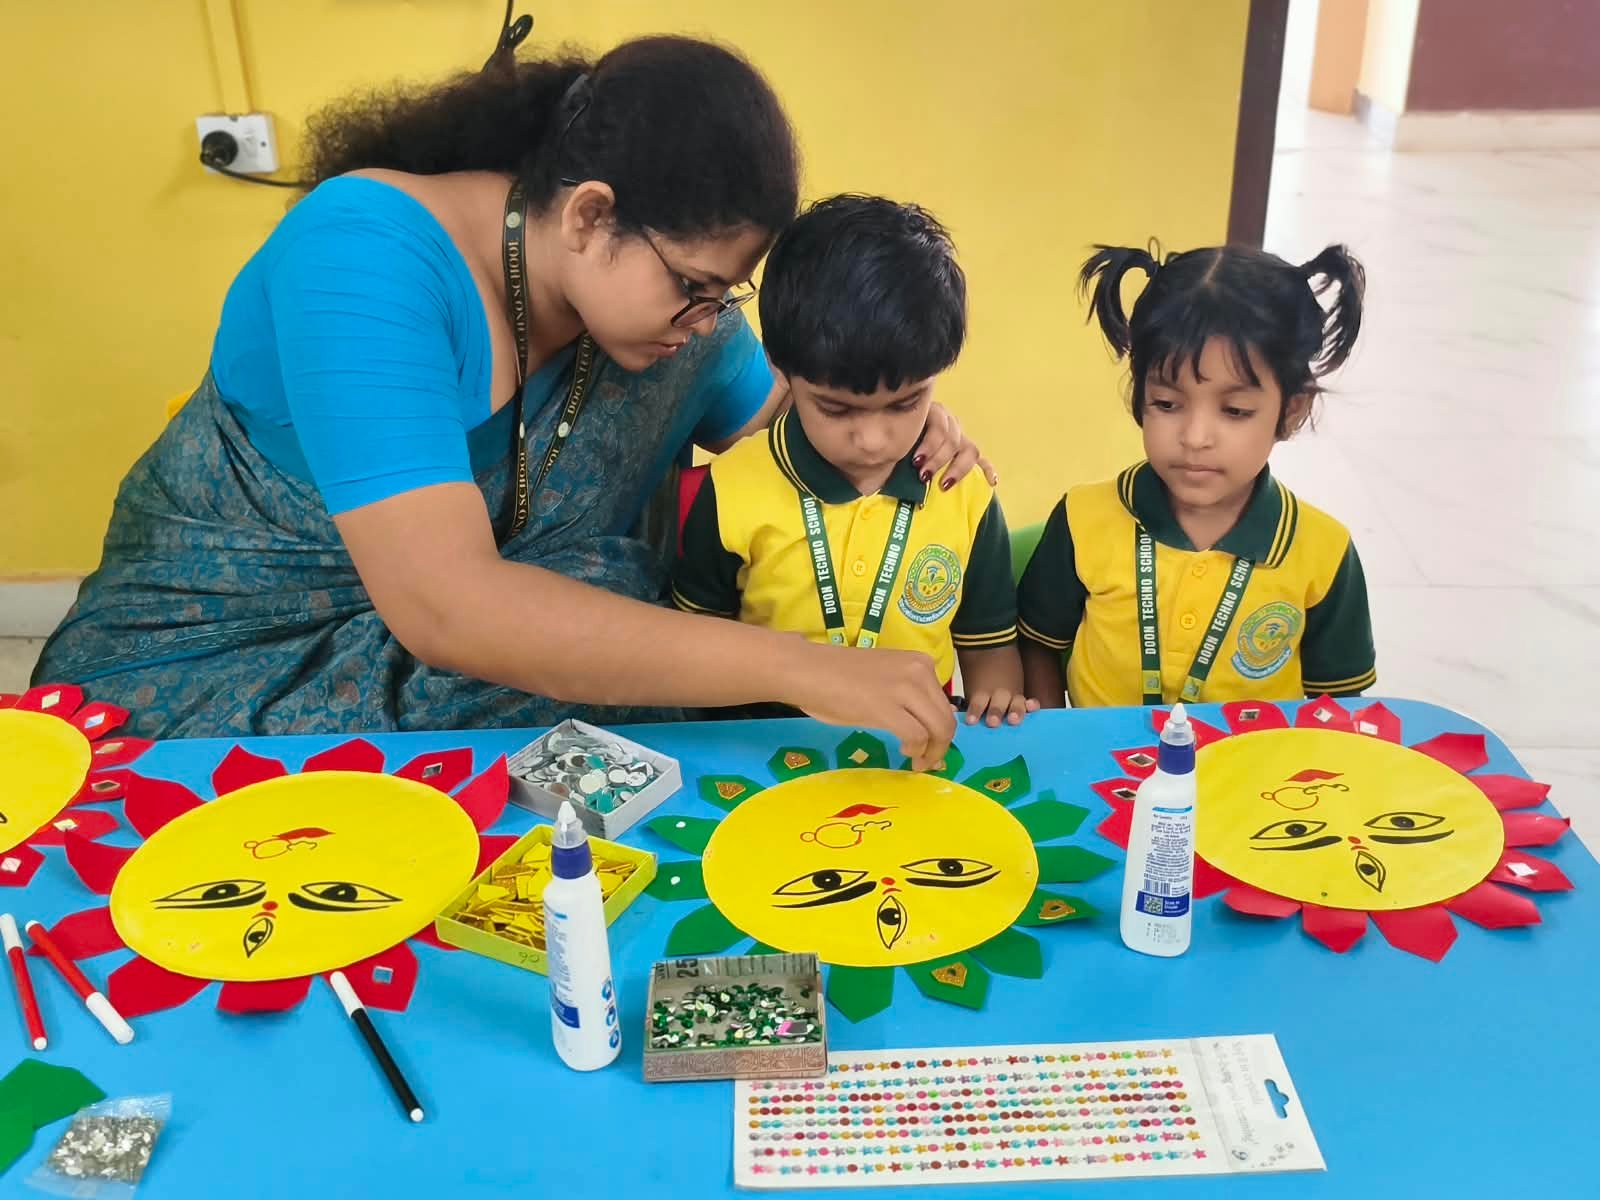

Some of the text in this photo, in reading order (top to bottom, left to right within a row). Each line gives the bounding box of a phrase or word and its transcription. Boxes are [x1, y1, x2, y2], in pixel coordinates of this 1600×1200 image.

[812, 540, 830, 581] TECHNO
[869, 503, 911, 617] DOON TECHNO SCHOOL
[821, 586, 837, 614] DOON
[1141, 578, 1154, 620] TECHNO
[1198, 557, 1250, 665] DOON TECHNO SCHO
[1145, 625, 1156, 655] DOON
